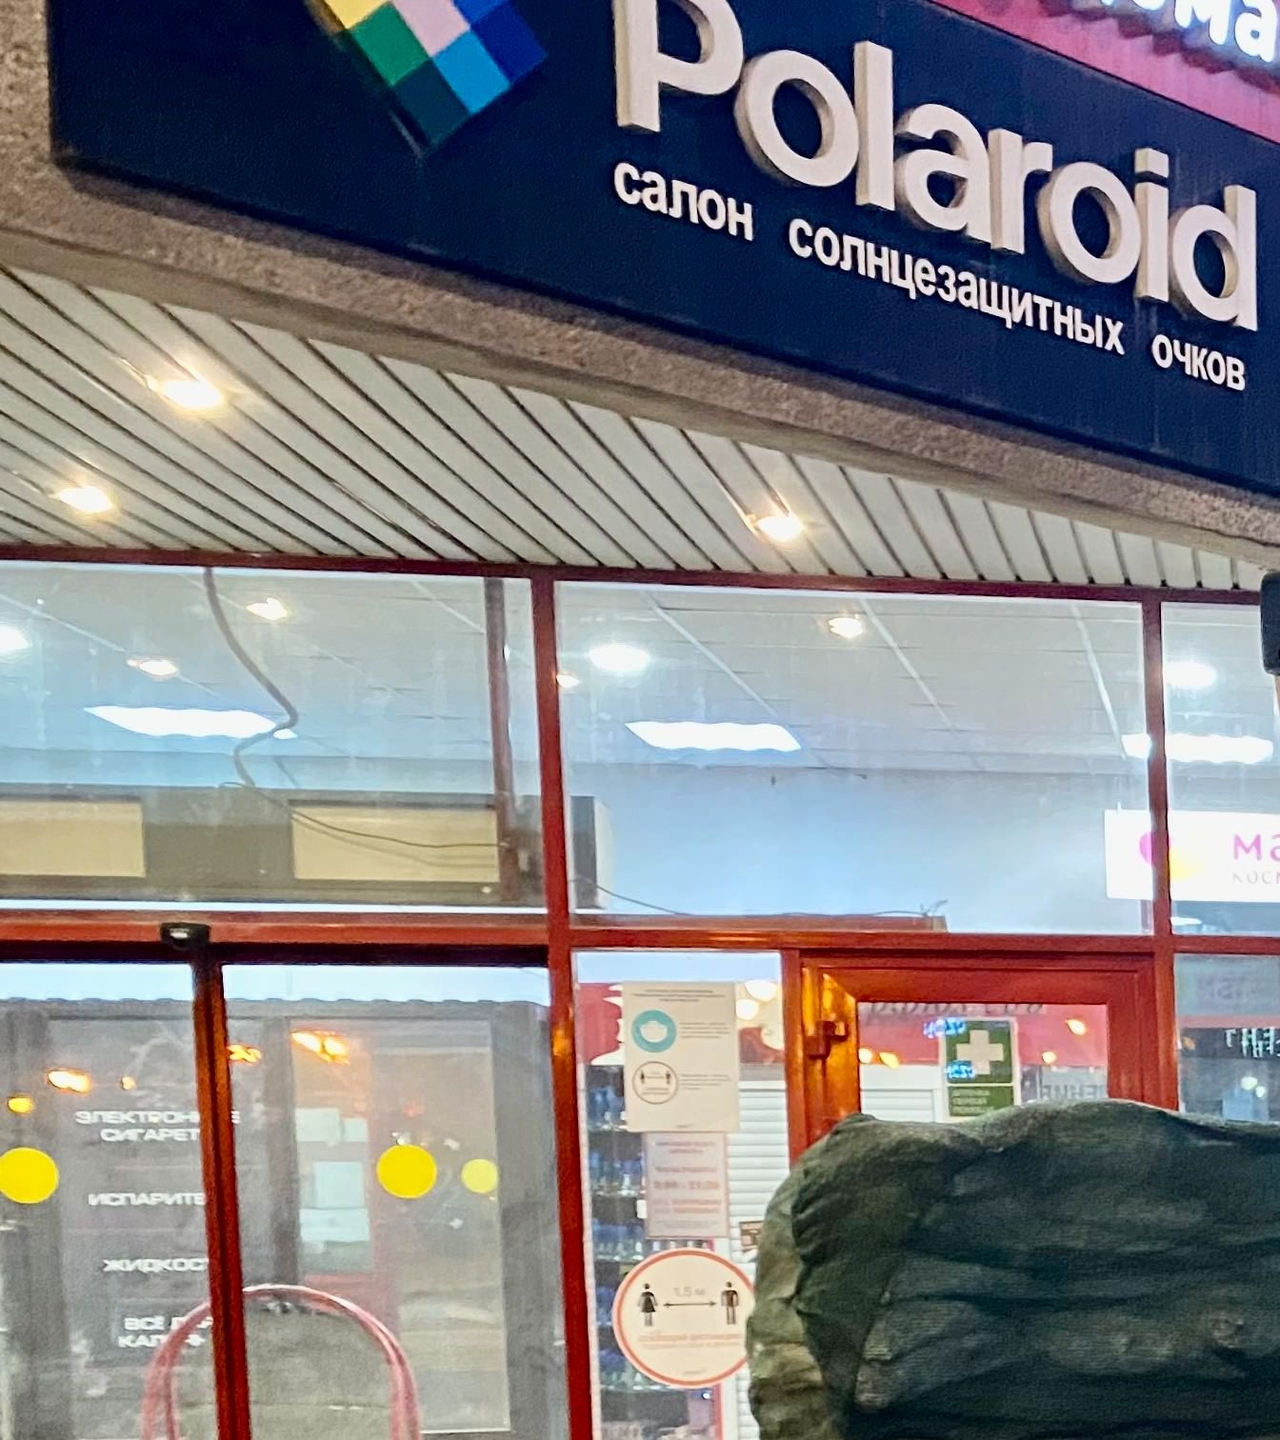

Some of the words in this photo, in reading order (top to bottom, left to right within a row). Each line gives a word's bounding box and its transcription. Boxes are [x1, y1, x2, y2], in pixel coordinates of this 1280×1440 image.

[613, 0, 1258, 331] Polaroid
[614, 161, 753, 241] салон
[788, 217, 1125, 356] солнцезащитных
[1152, 332, 1246, 391] очков
[100, 1128, 200, 1142] СИГАРЕТ
